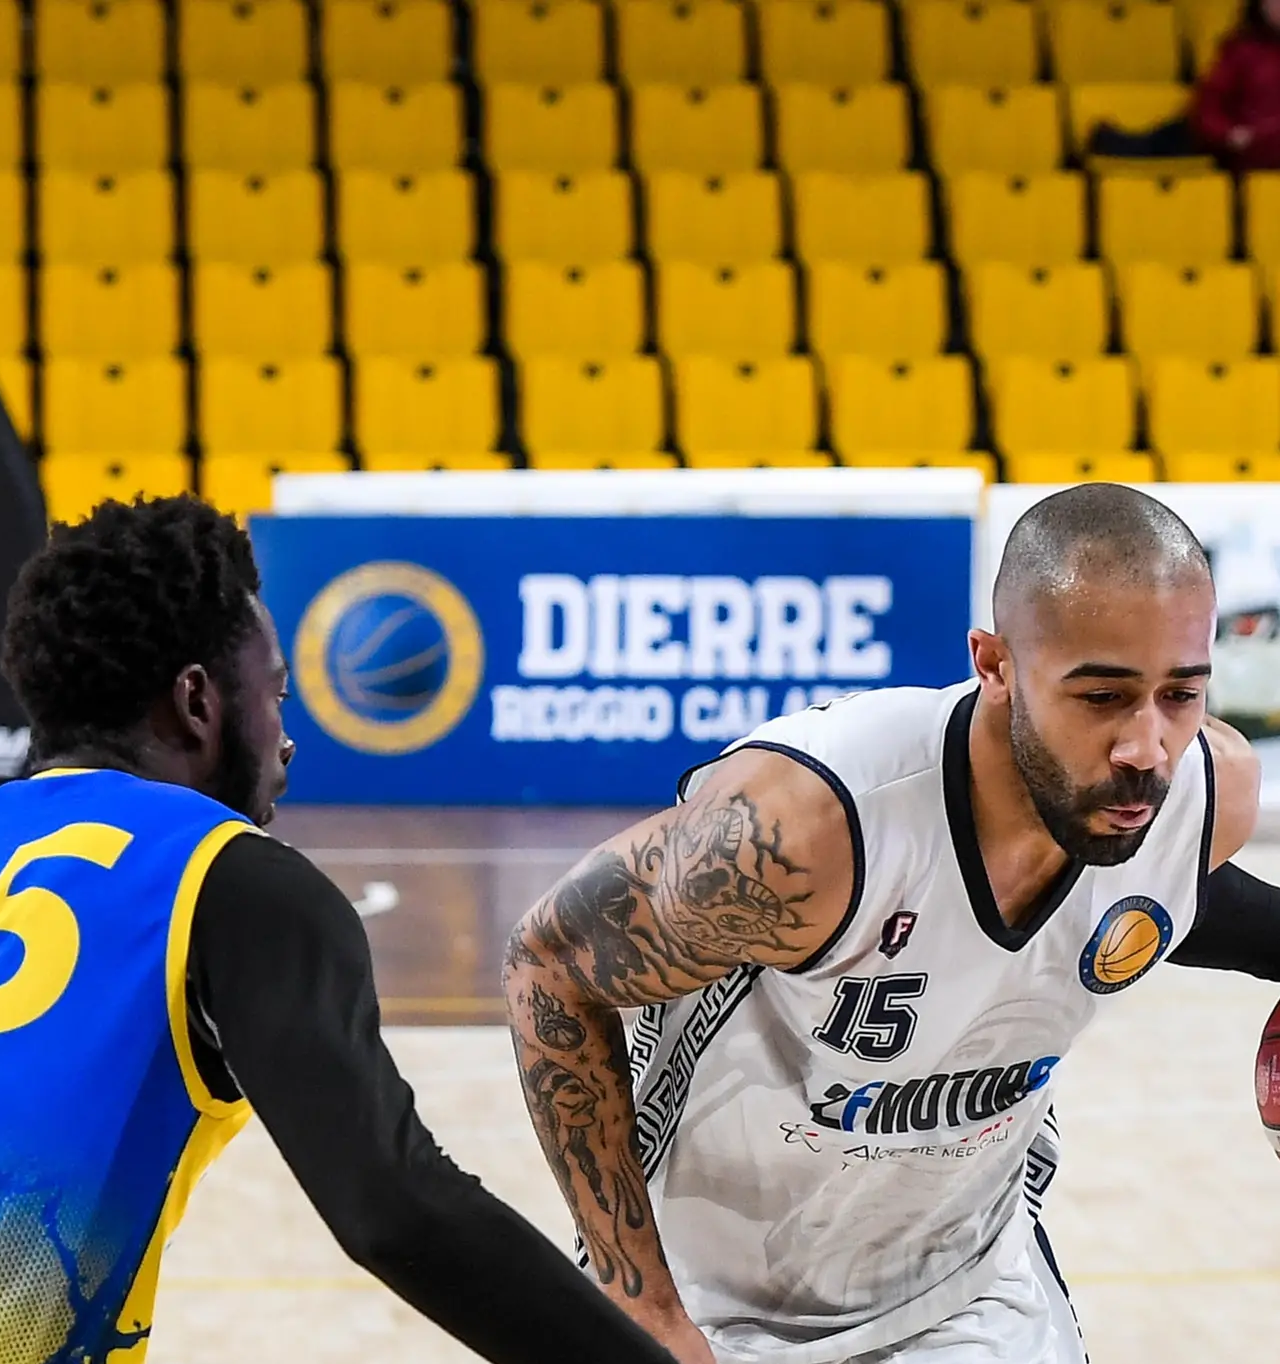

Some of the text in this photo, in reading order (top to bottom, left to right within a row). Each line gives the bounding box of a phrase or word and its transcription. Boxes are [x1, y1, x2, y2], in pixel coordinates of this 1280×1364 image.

[518, 574, 893, 680] DIERRE
[491, 685, 674, 741] REGGIO
[812, 973, 928, 1062] 15
